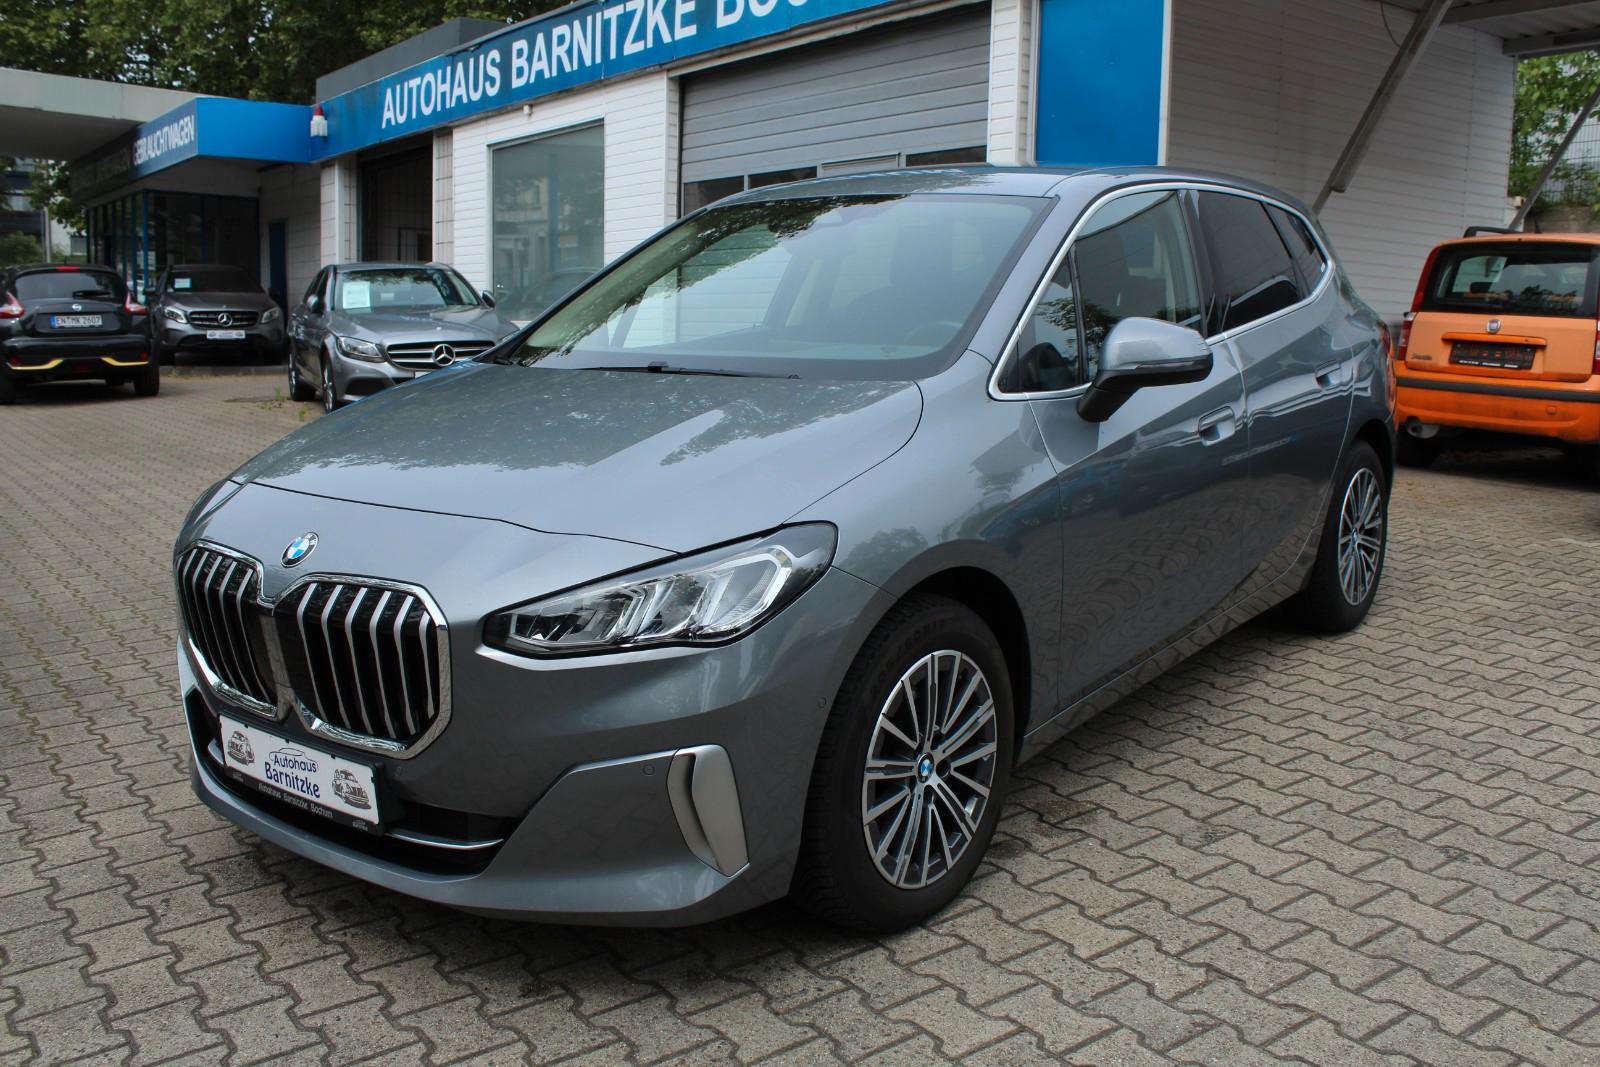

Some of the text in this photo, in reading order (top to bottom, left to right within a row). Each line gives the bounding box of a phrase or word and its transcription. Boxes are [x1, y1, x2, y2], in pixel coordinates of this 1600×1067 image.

[381, 0, 697, 129] AUTOHAUS BARNITZKE
[133, 115, 195, 166] GEBRAUCHTWAGEN
[264, 761, 321, 799] Barnitzke
[273, 754, 318, 773] Autohaus
